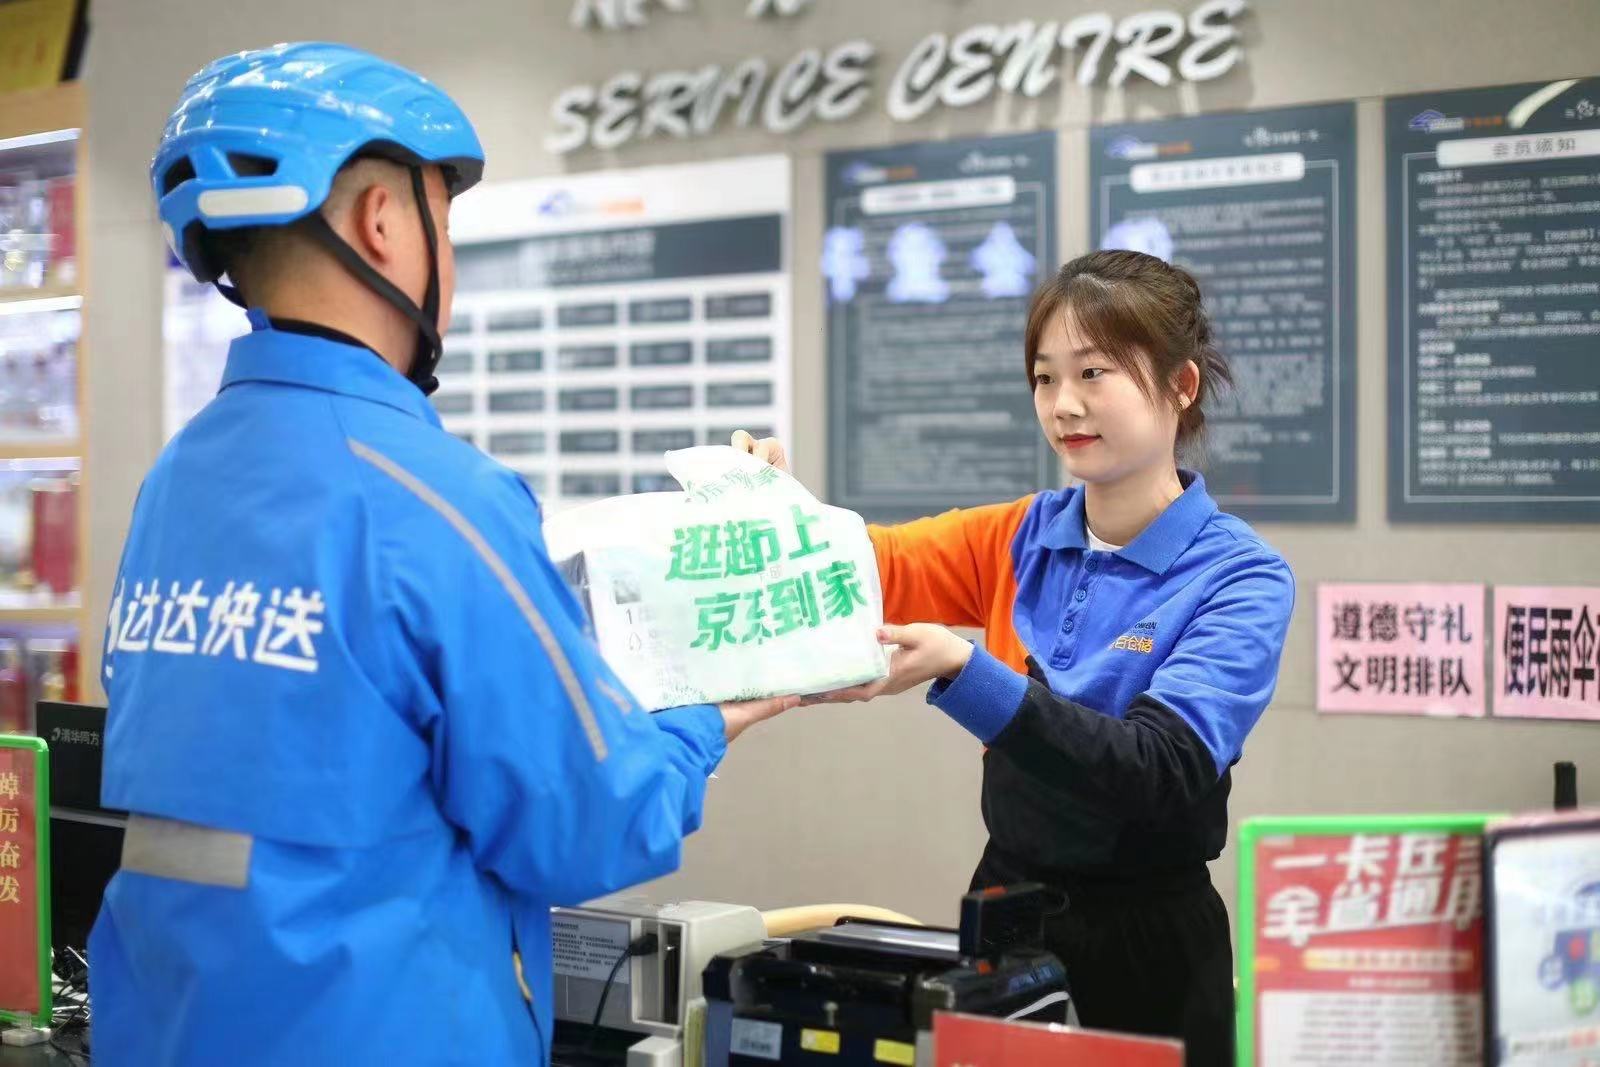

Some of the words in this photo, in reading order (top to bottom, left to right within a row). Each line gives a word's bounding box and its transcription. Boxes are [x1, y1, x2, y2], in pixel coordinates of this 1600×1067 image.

[544, 41, 873, 154] SERVICE
[888, 0, 1246, 121] CENTRE
[117, 578, 325, 672] 达达快送
[1331, 602, 1473, 643] 遵德守礼
[1504, 604, 1600, 701] 便民雨伞
[1331, 652, 1473, 697] 文明排队
[61, 728, 99, 746] 清华同方
